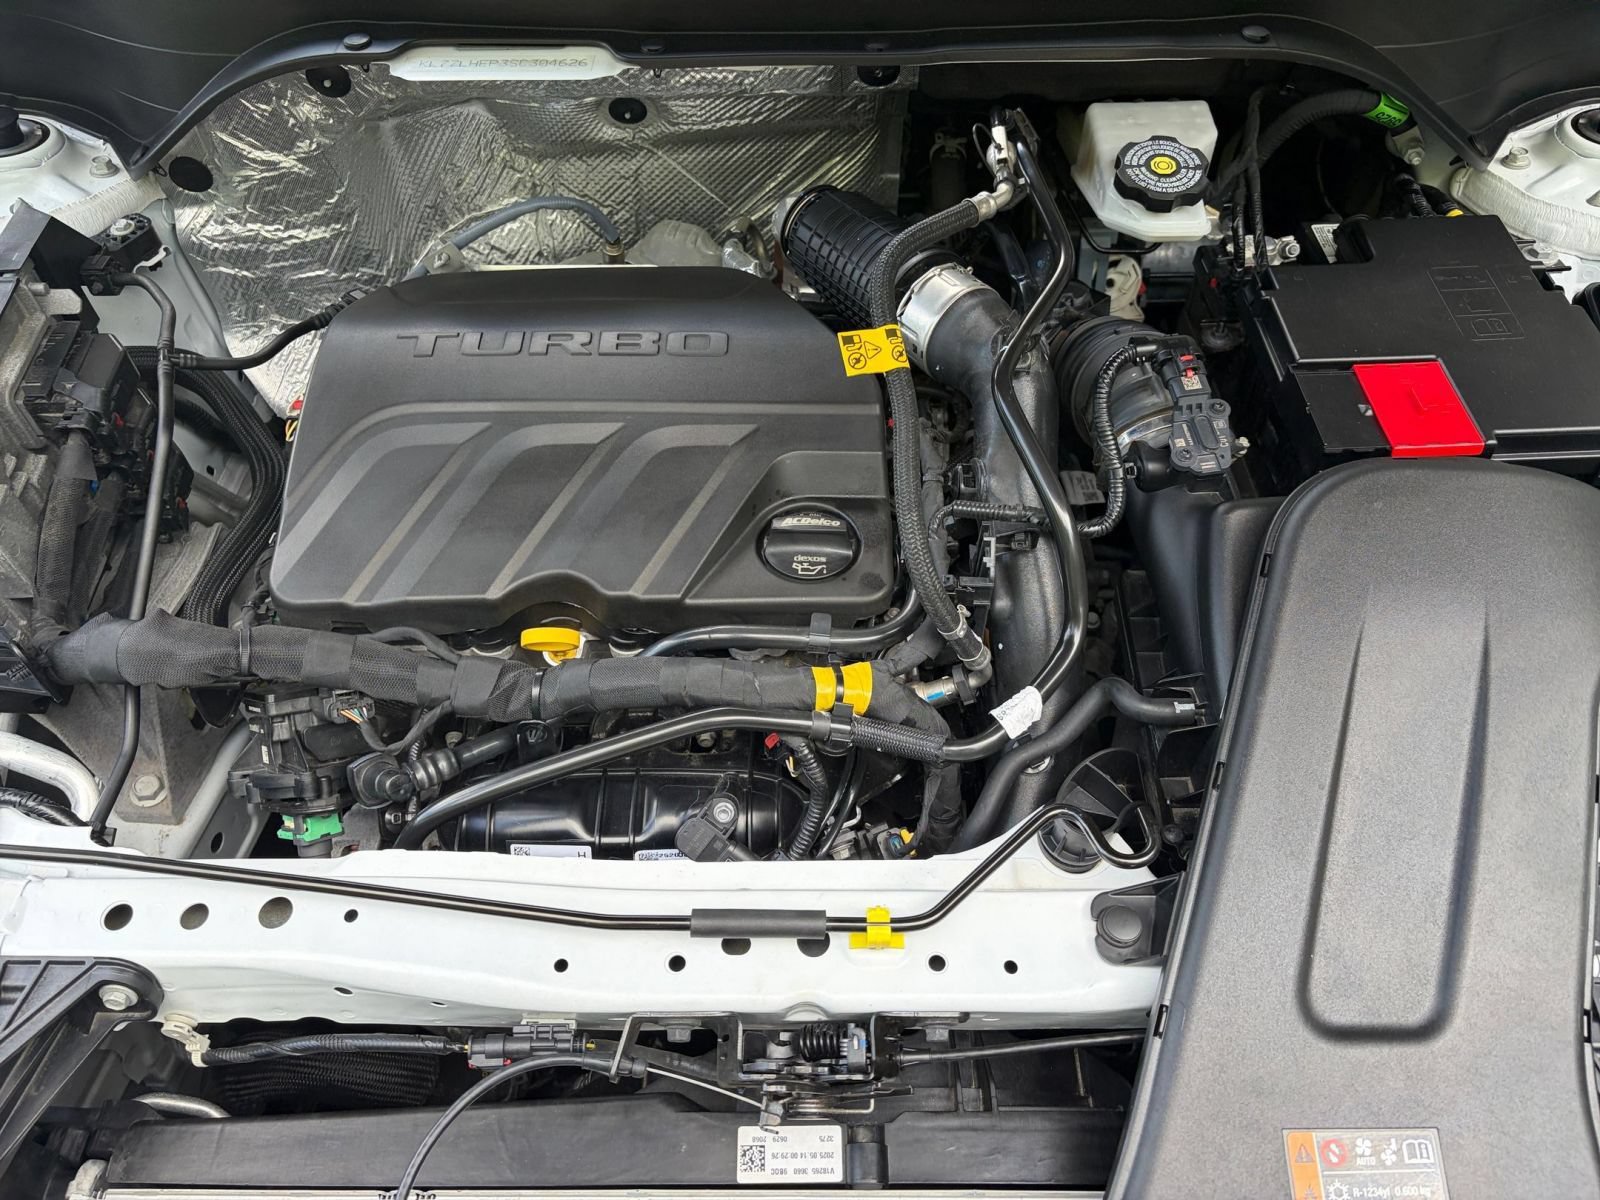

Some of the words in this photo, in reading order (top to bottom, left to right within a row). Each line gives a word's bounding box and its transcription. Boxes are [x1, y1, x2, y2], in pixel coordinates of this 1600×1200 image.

[1146, 184, 1162, 192] FROM
[396, 330, 731, 358] TURBO
[780, 517, 841, 527] ACDelco
[793, 554, 827, 562] dexos
[772, 1135, 788, 1143] 0629
[819, 1135, 834, 1144] 3275
[800, 1151, 835, 1159] 2025.05.14
[1356, 1156, 1376, 1166] AUTO
